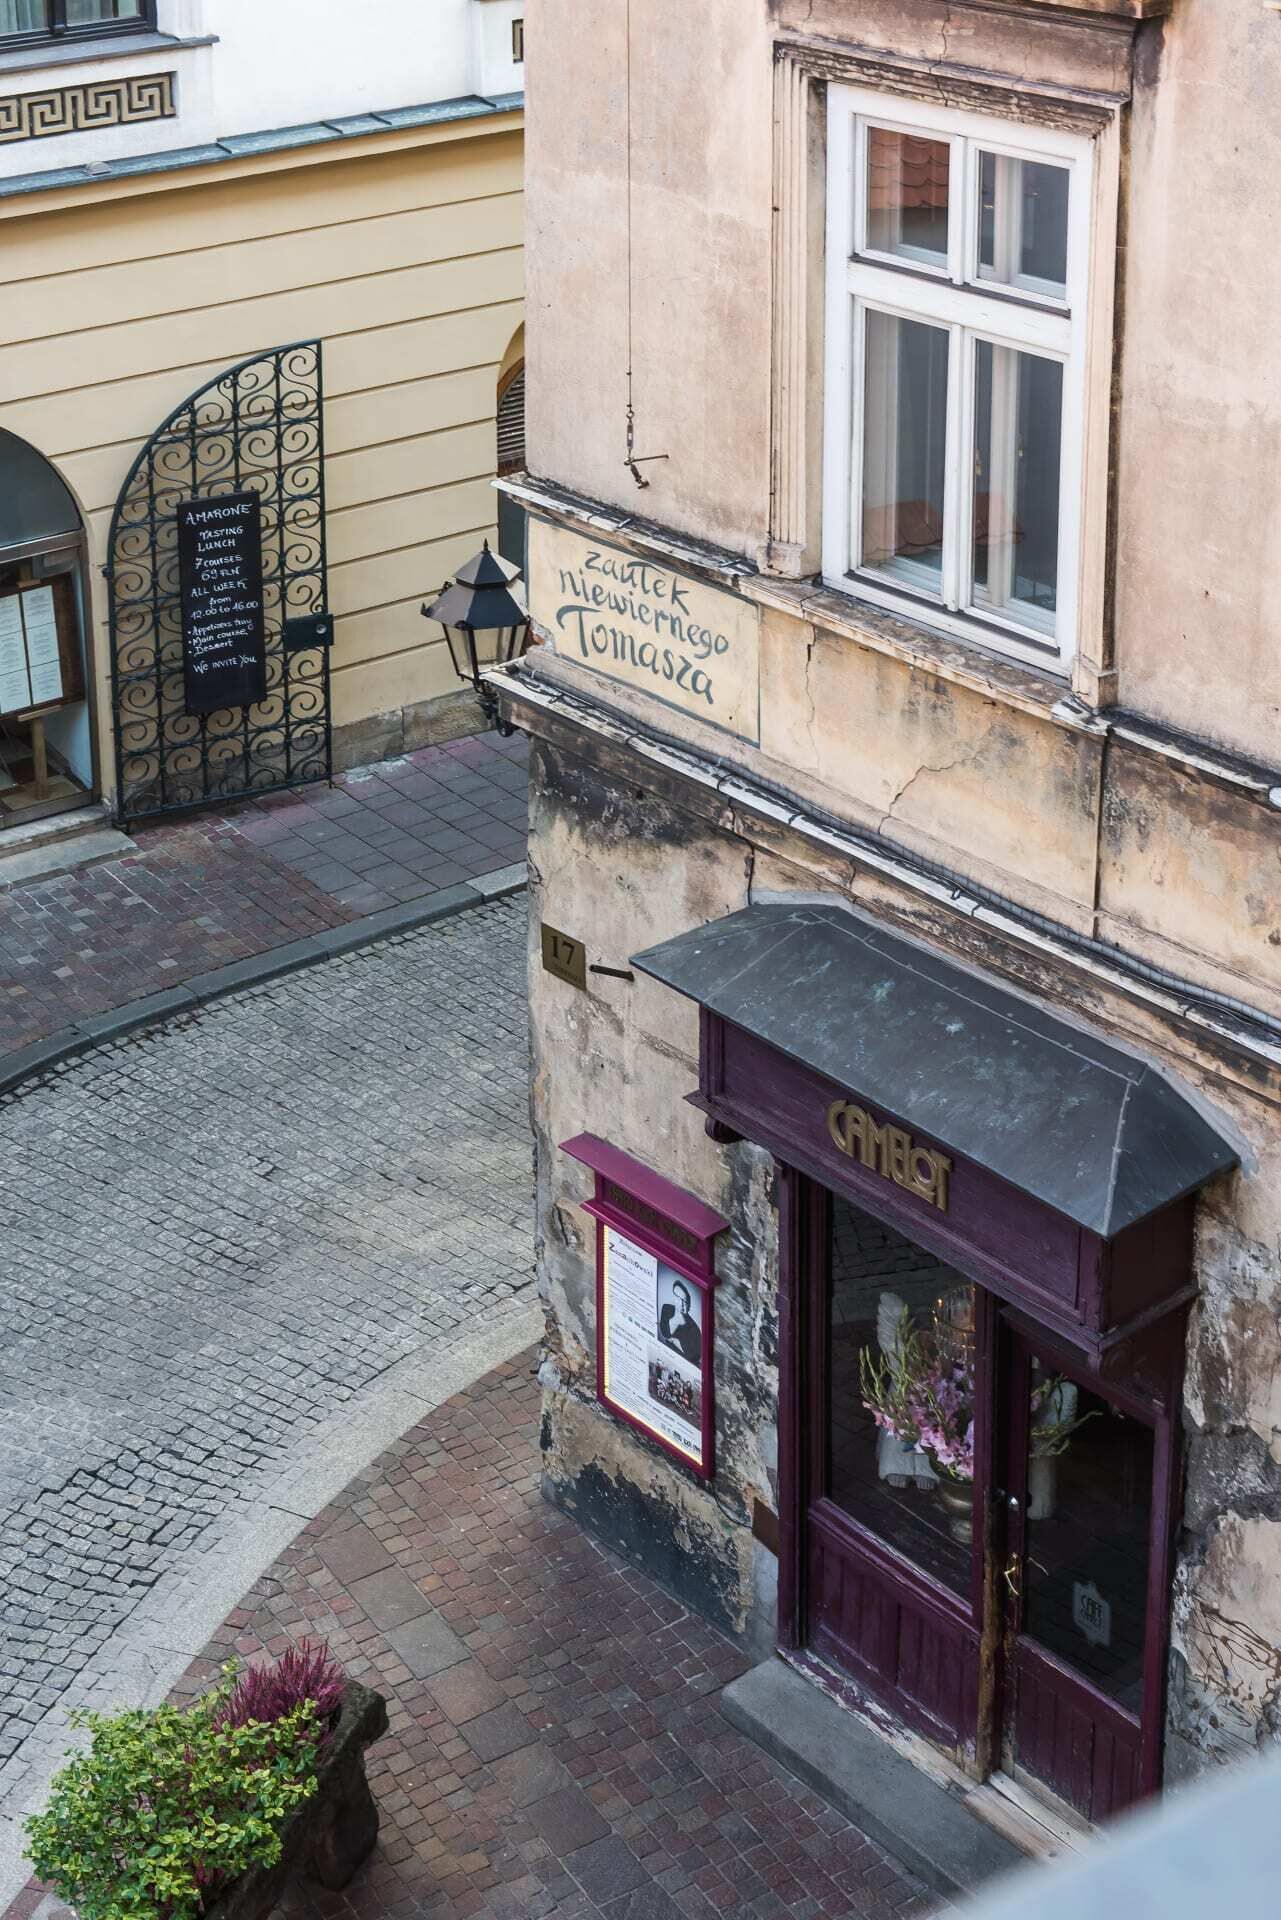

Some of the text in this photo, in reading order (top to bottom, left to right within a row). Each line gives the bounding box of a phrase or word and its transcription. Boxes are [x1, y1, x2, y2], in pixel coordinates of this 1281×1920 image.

[185, 503, 253, 525] AMARONE
[199, 525, 244, 540] TASTING
[197, 538, 236, 552] LUNCH
[191, 578, 248, 598] ALL WEEK
[190, 600, 259, 620] 12.00 to 16.00
[209, 596, 232, 608] from
[559, 567, 729, 660] niewiernego
[192, 635, 214, 646] Main
[555, 603, 714, 705] Tomasza
[192, 660, 209, 674] We
[212, 657, 238, 669] INVITE
[550, 935, 575, 965] 17
